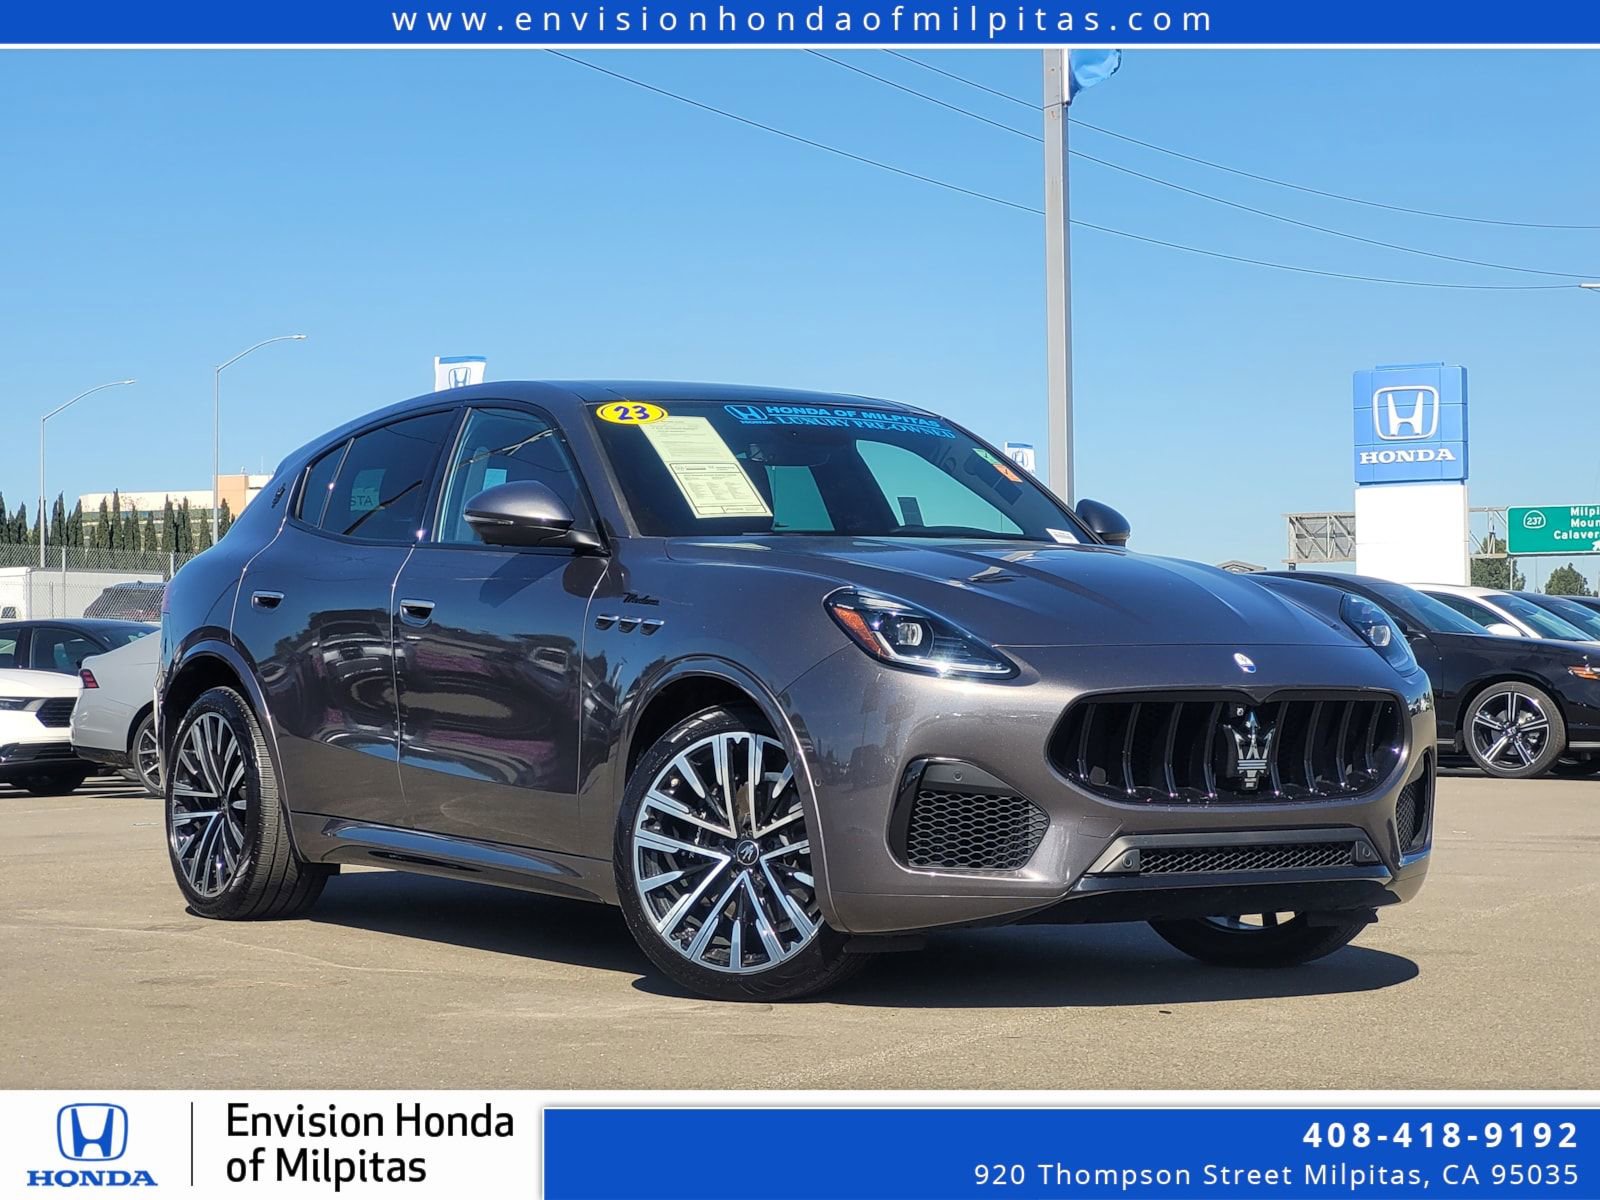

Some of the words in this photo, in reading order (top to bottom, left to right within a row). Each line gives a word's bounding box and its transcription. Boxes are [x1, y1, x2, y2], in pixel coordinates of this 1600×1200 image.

[614, 405, 650, 421] 23
[765, 406, 831, 416] HONDA
[833, 409, 857, 418] OF
[861, 411, 941, 428] MILPITAS
[776, 416, 850, 428] LUXURY
[1359, 448, 1456, 465] HONDA
[1526, 516, 1543, 526] 237
